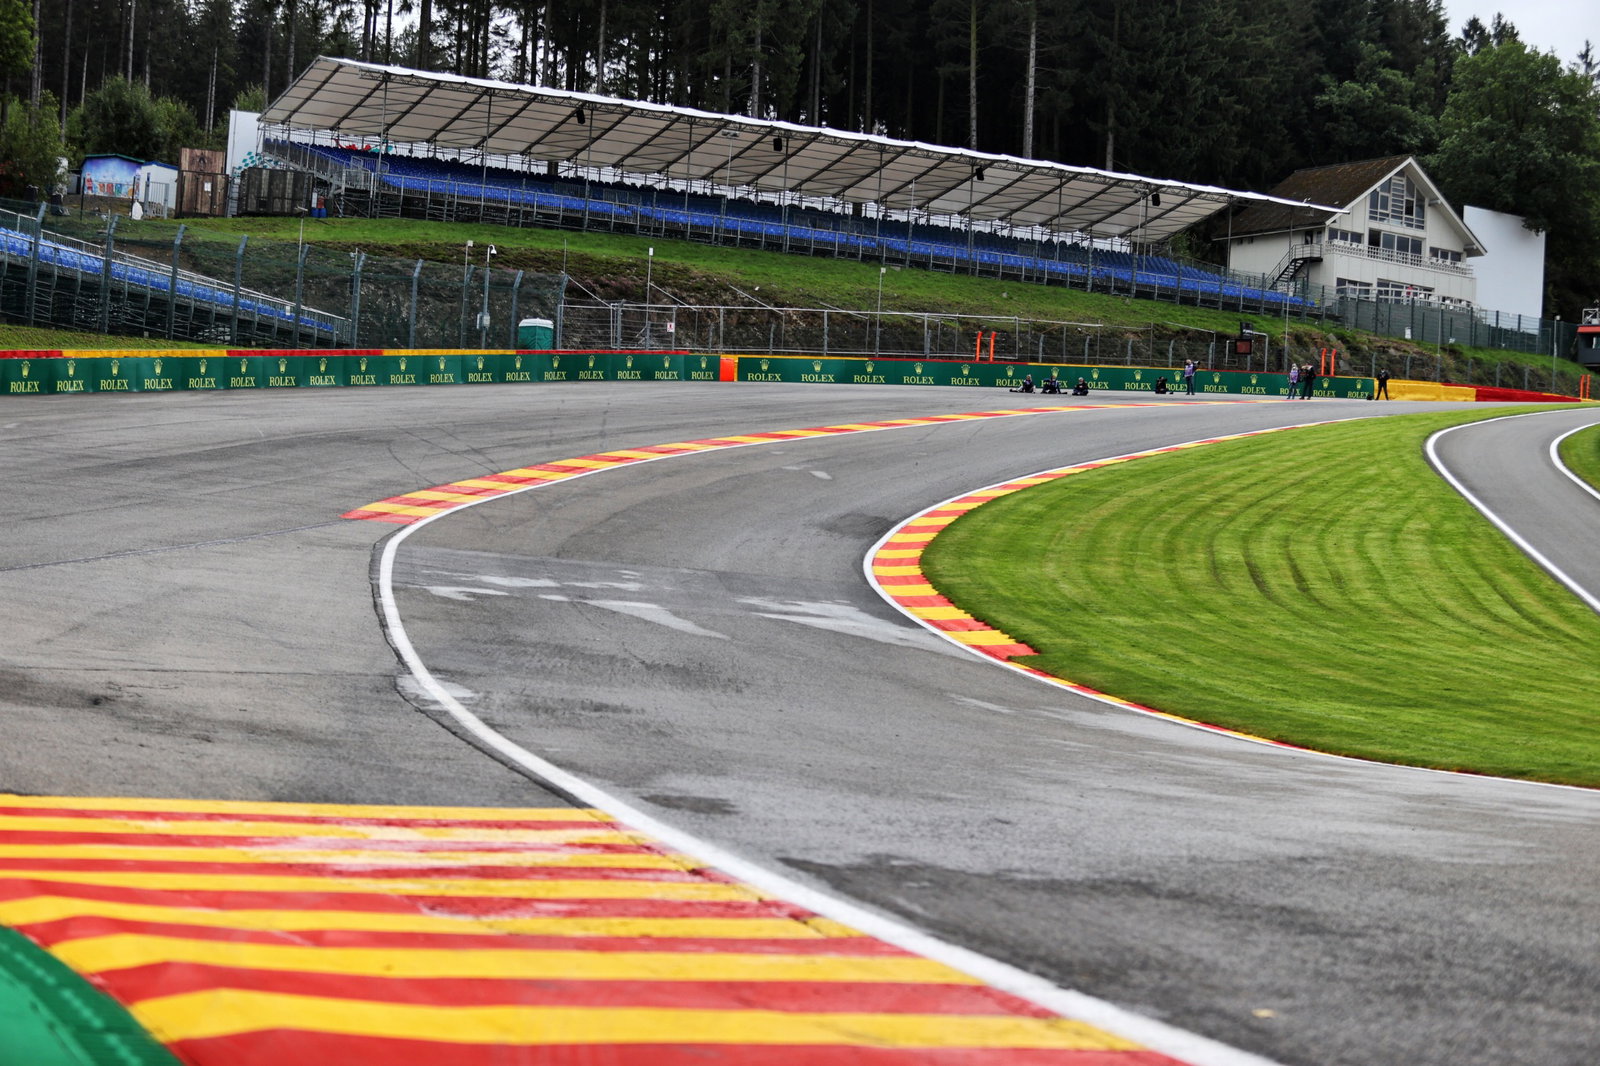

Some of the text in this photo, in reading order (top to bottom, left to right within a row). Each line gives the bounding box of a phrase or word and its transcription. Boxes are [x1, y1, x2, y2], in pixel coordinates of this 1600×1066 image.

[350, 374, 376, 384] ROLEX
[390, 374, 416, 384] ROLEX
[430, 374, 454, 384] ROLEX
[468, 372, 492, 382] ROLEX
[506, 372, 530, 382] ROLEX
[544, 372, 566, 380] ROLEX
[578, 370, 604, 380] ROLEX
[618, 370, 640, 380] ROLEX
[654, 370, 678, 380] ROLEX
[692, 372, 714, 380] ROLEX
[748, 372, 780, 382] ROLEX
[802, 374, 834, 382] ROLEX
[854, 374, 884, 384] ROLEX
[904, 376, 934, 384] ROLEX
[56, 380, 84, 392] ROLEX
[100, 380, 128, 390] ROLEX
[144, 378, 172, 390] ROLEX
[188, 378, 216, 388] ROLEX
[230, 376, 256, 388] ROLEX
[270, 376, 296, 386] ROLEX
[310, 376, 336, 386] ROLEX
[952, 378, 980, 386] ROLEX
[996, 379, 1024, 387] ROLEX
[1124, 382, 1152, 390] ROLEX
[10, 382, 40, 392] ROLEX
